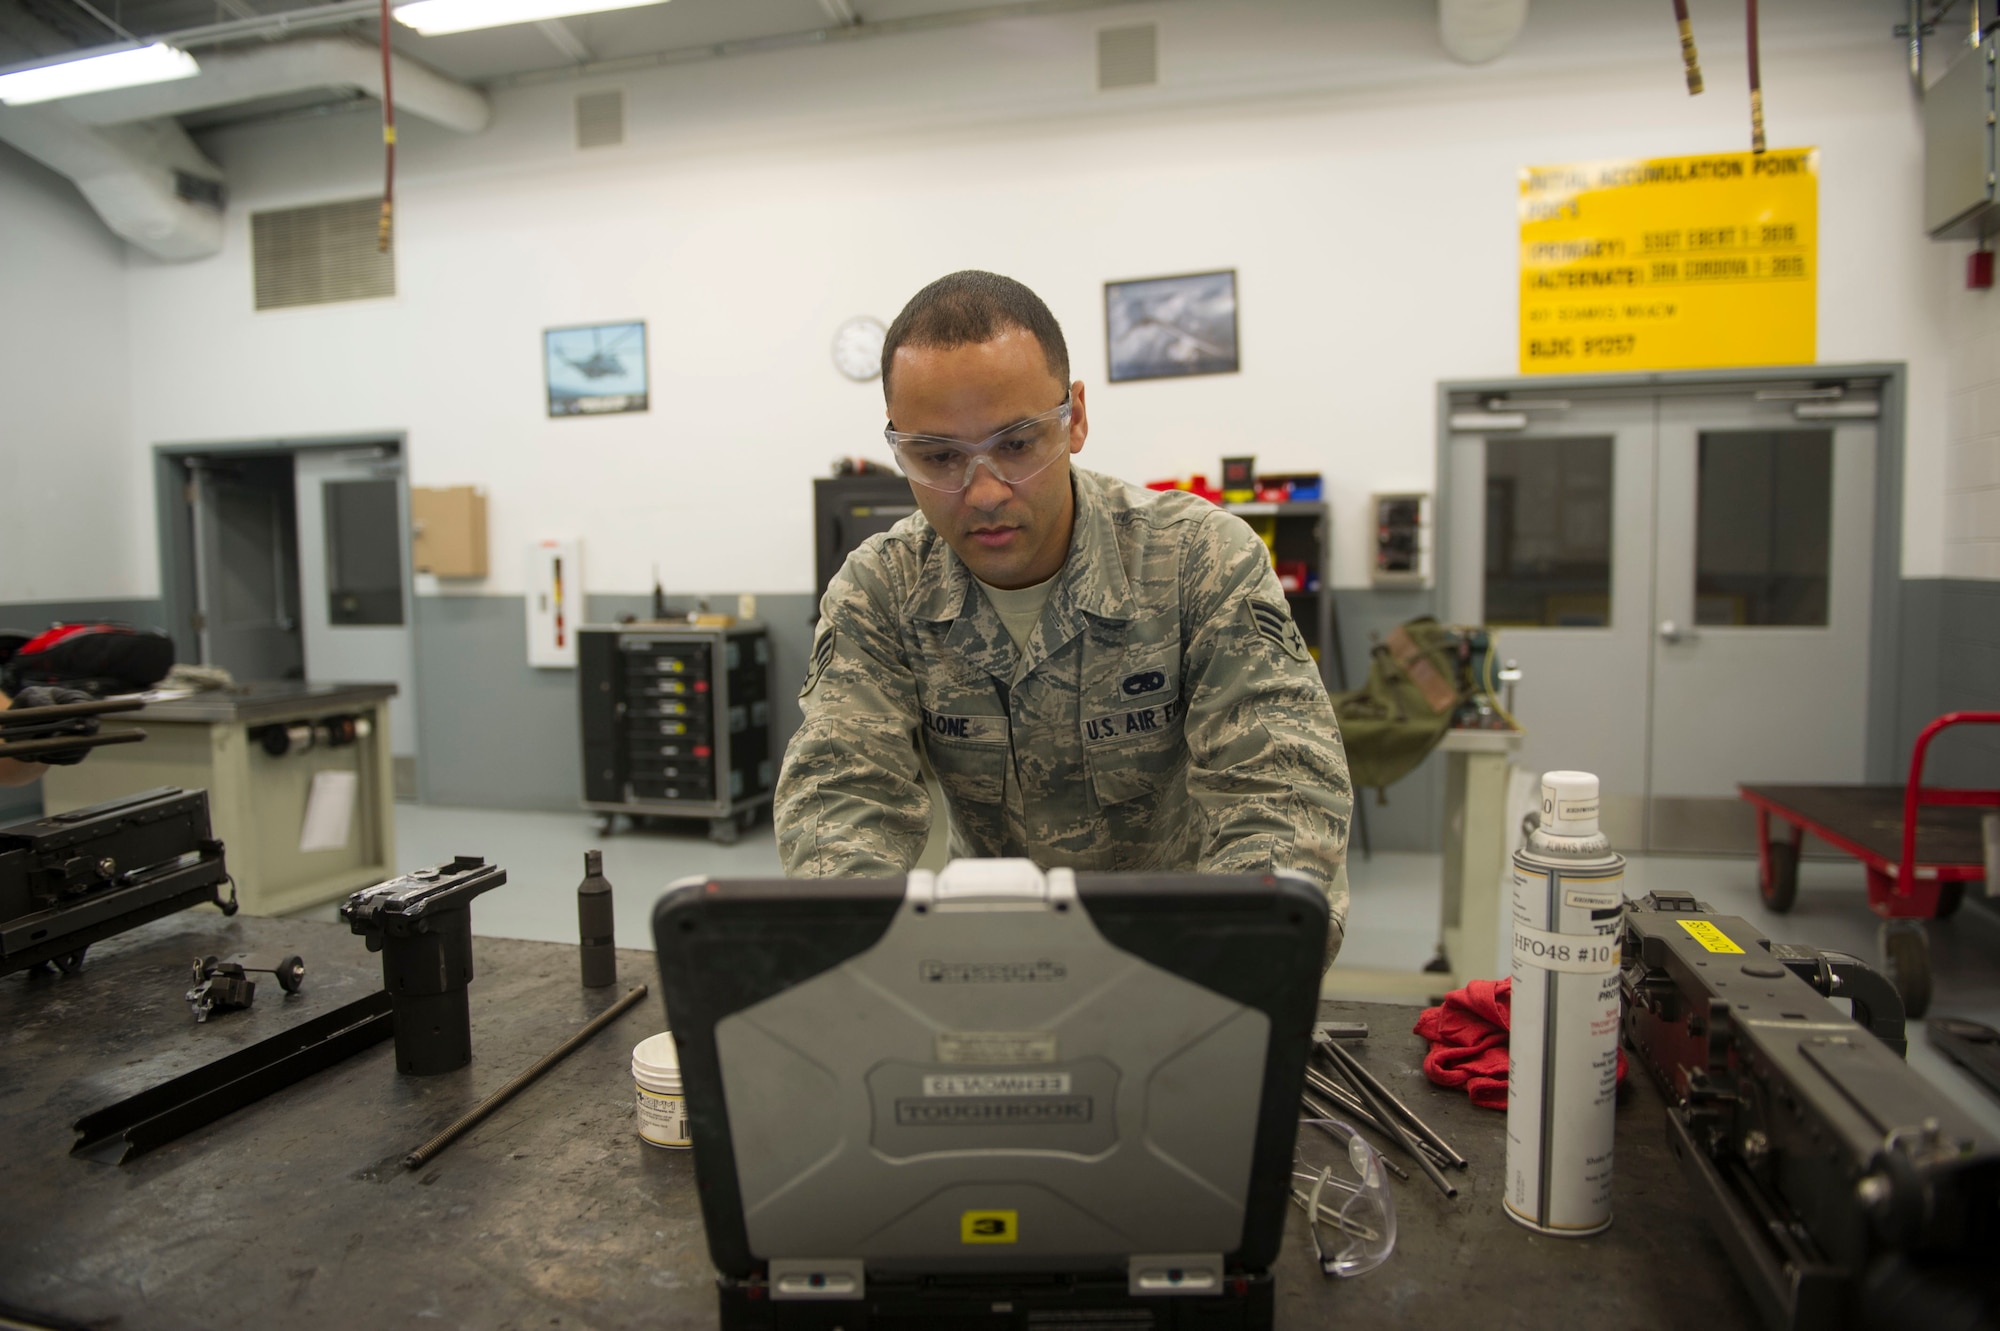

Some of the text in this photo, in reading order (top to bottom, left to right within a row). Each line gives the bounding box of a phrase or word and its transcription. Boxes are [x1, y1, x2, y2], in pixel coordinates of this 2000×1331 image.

[1599, 158, 1744, 188] ACCUMULATION
[1751, 154, 1809, 177] POINT
[1086, 718, 1118, 740] U.S.
[1126, 708, 1156, 734] AIR
[1545, 839, 1578, 854] ALWAYS
[1578, 946, 1609, 962] #10
[904, 1103, 1085, 1119] TOUGHBOOK
